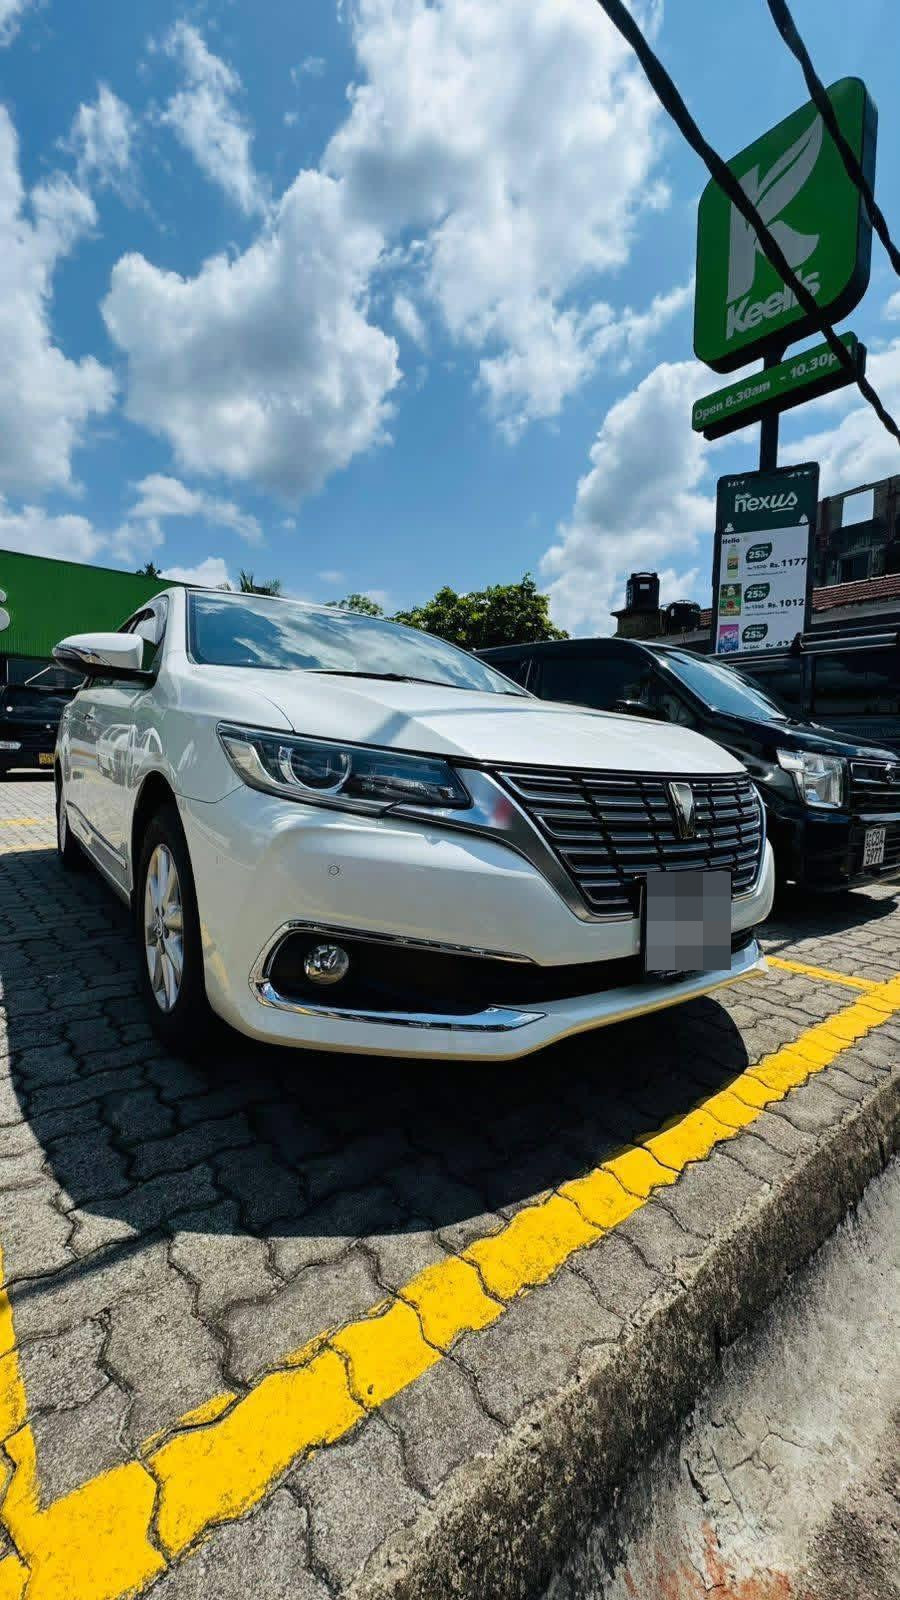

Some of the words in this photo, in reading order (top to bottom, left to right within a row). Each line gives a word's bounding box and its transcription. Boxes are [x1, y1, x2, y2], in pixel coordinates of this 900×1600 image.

[695, 402, 723, 420] Open
[725, 381, 771, 407] 8.30am
[790, 345, 852, 377] 10.30p
[734, 491, 798, 512] nexus
[781, 557, 807, 567] 1177
[780, 598, 804, 607] 1012
